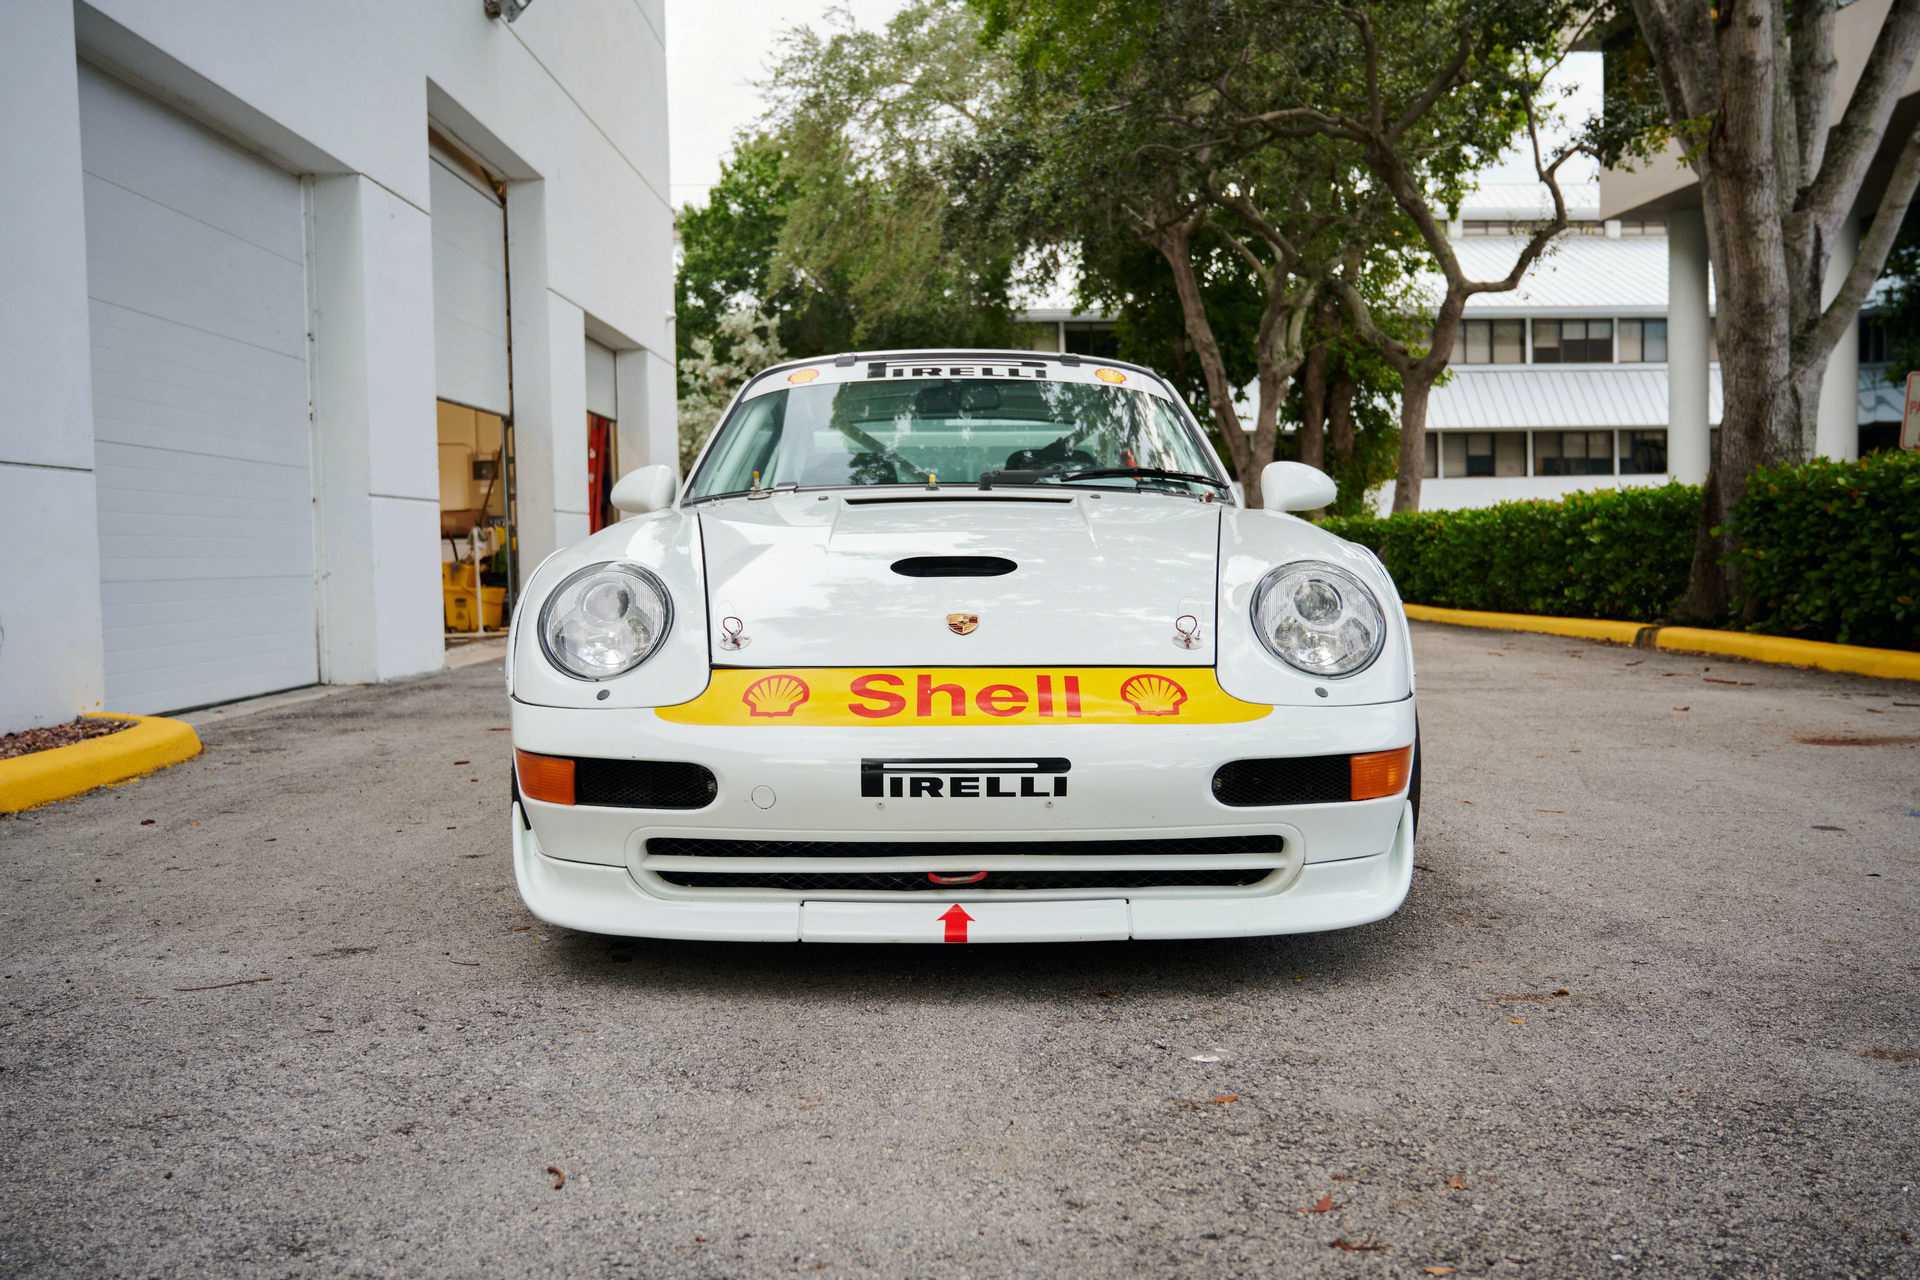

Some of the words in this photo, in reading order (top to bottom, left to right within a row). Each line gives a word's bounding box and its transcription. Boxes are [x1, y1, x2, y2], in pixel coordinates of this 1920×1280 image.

[867, 360, 1047, 379] PIRELLI
[848, 674, 1082, 718] Shell
[861, 757, 1071, 797] PIRELLI
